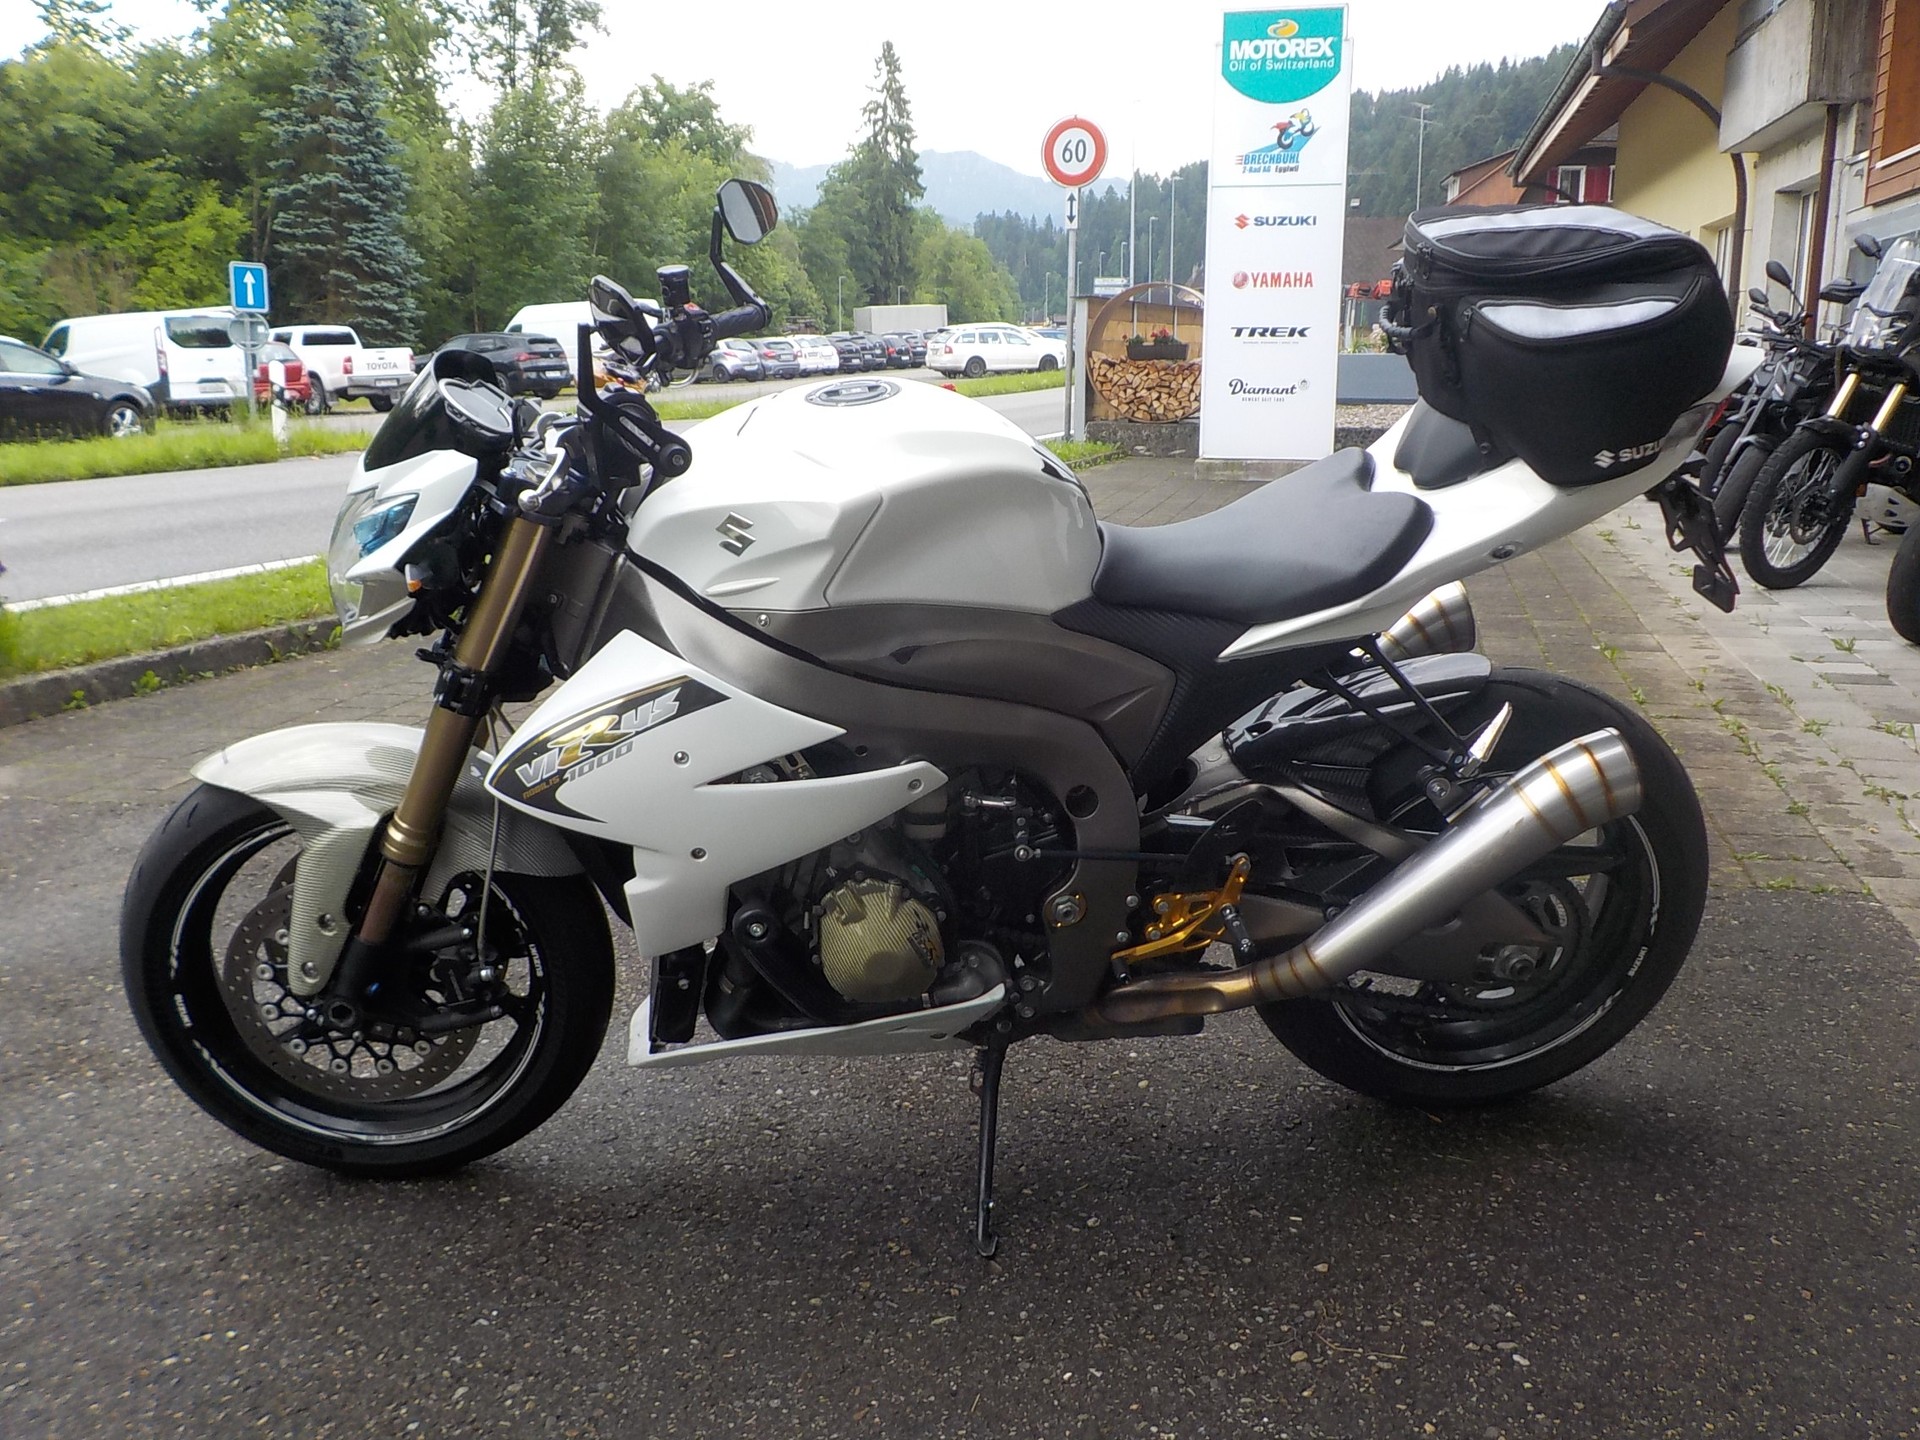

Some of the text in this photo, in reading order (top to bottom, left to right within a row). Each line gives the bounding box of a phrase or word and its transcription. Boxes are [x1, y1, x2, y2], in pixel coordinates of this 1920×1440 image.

[1230, 37, 1334, 60] MOTOREX
[1229, 58, 1335, 72] Oil of Switzerland
[1062, 138, 1087, 164] 60
[1253, 215, 1317, 226] SUZUKI
[1250, 271, 1314, 288] YAMAHA
[1230, 326, 1312, 337] TREK
[366, 362, 398, 370] TOYOTA
[1228, 378, 1297, 395] Diamant
[563, 741, 633, 782] 1000
[1628, 946, 1649, 977] SUZUKI
